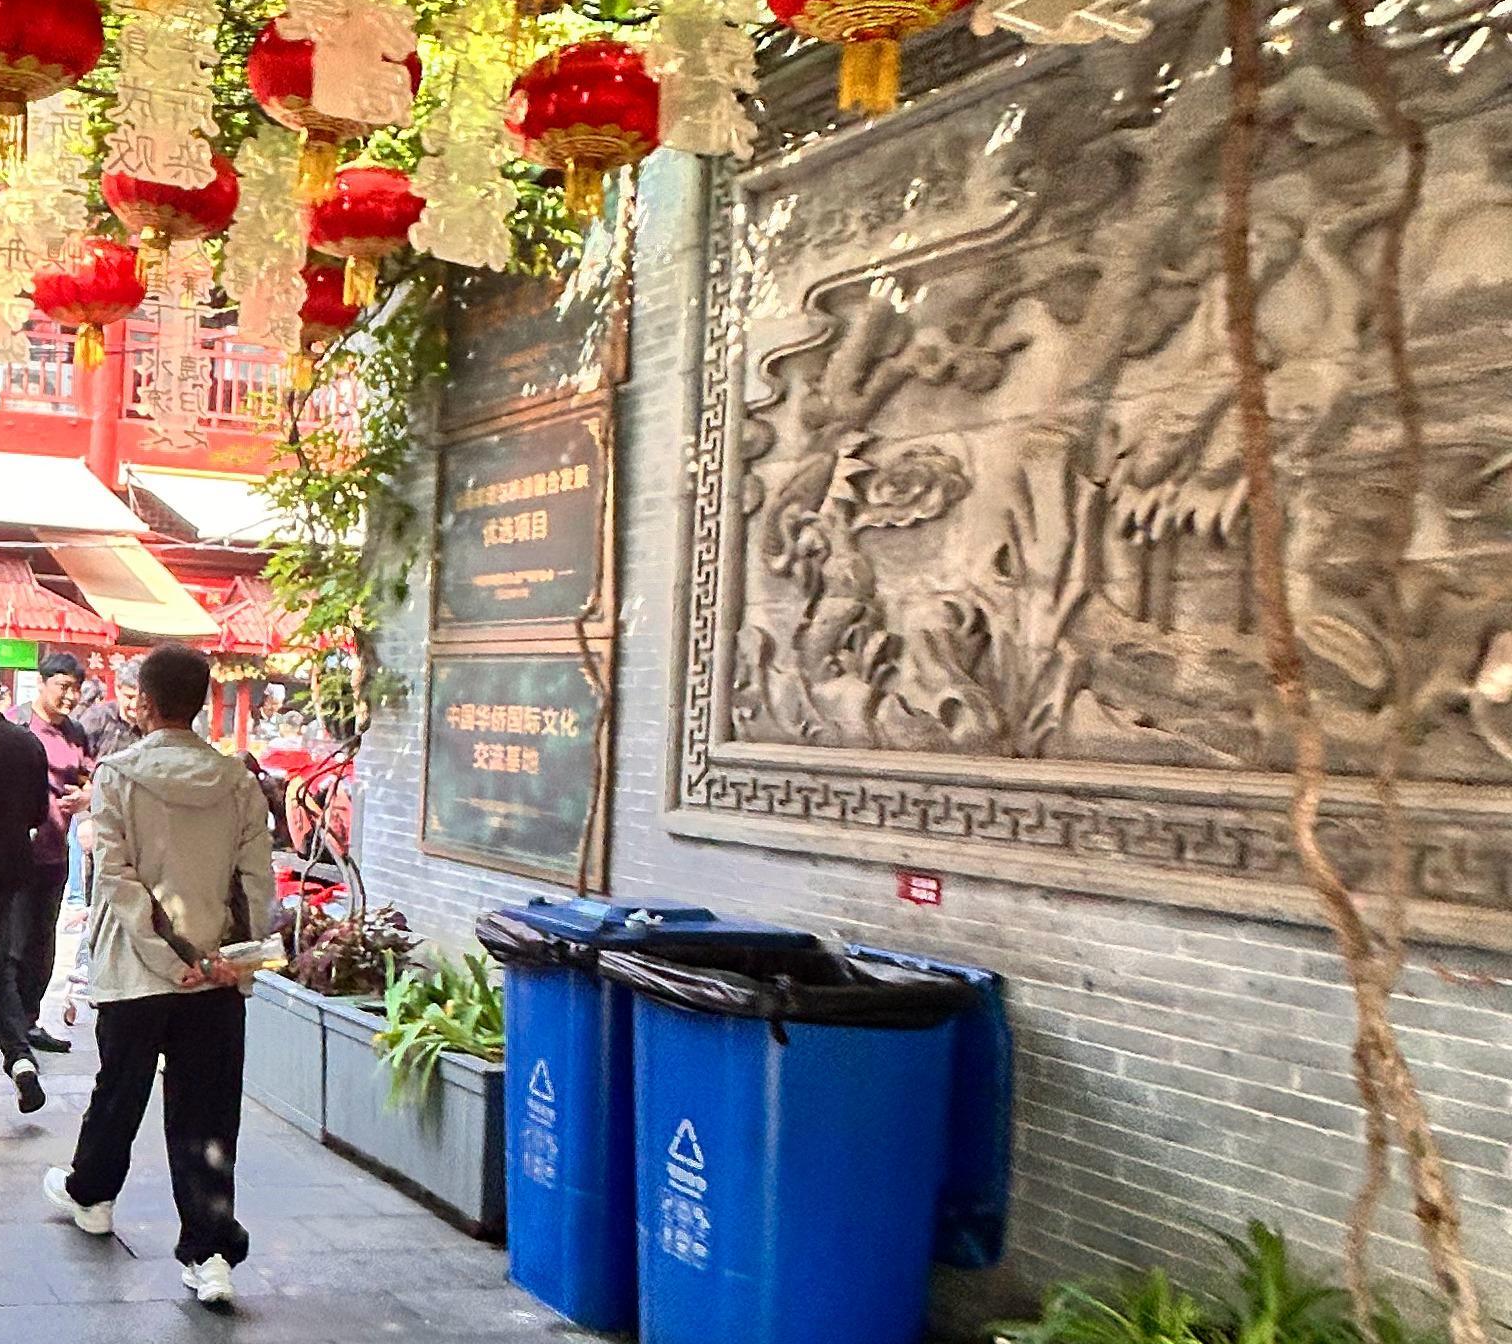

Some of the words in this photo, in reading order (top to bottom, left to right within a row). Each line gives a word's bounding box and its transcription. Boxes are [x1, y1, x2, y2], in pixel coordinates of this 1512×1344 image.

[444, 702, 580, 738] 中国华侨国际文化
[472, 740, 541, 776] 交流基地
